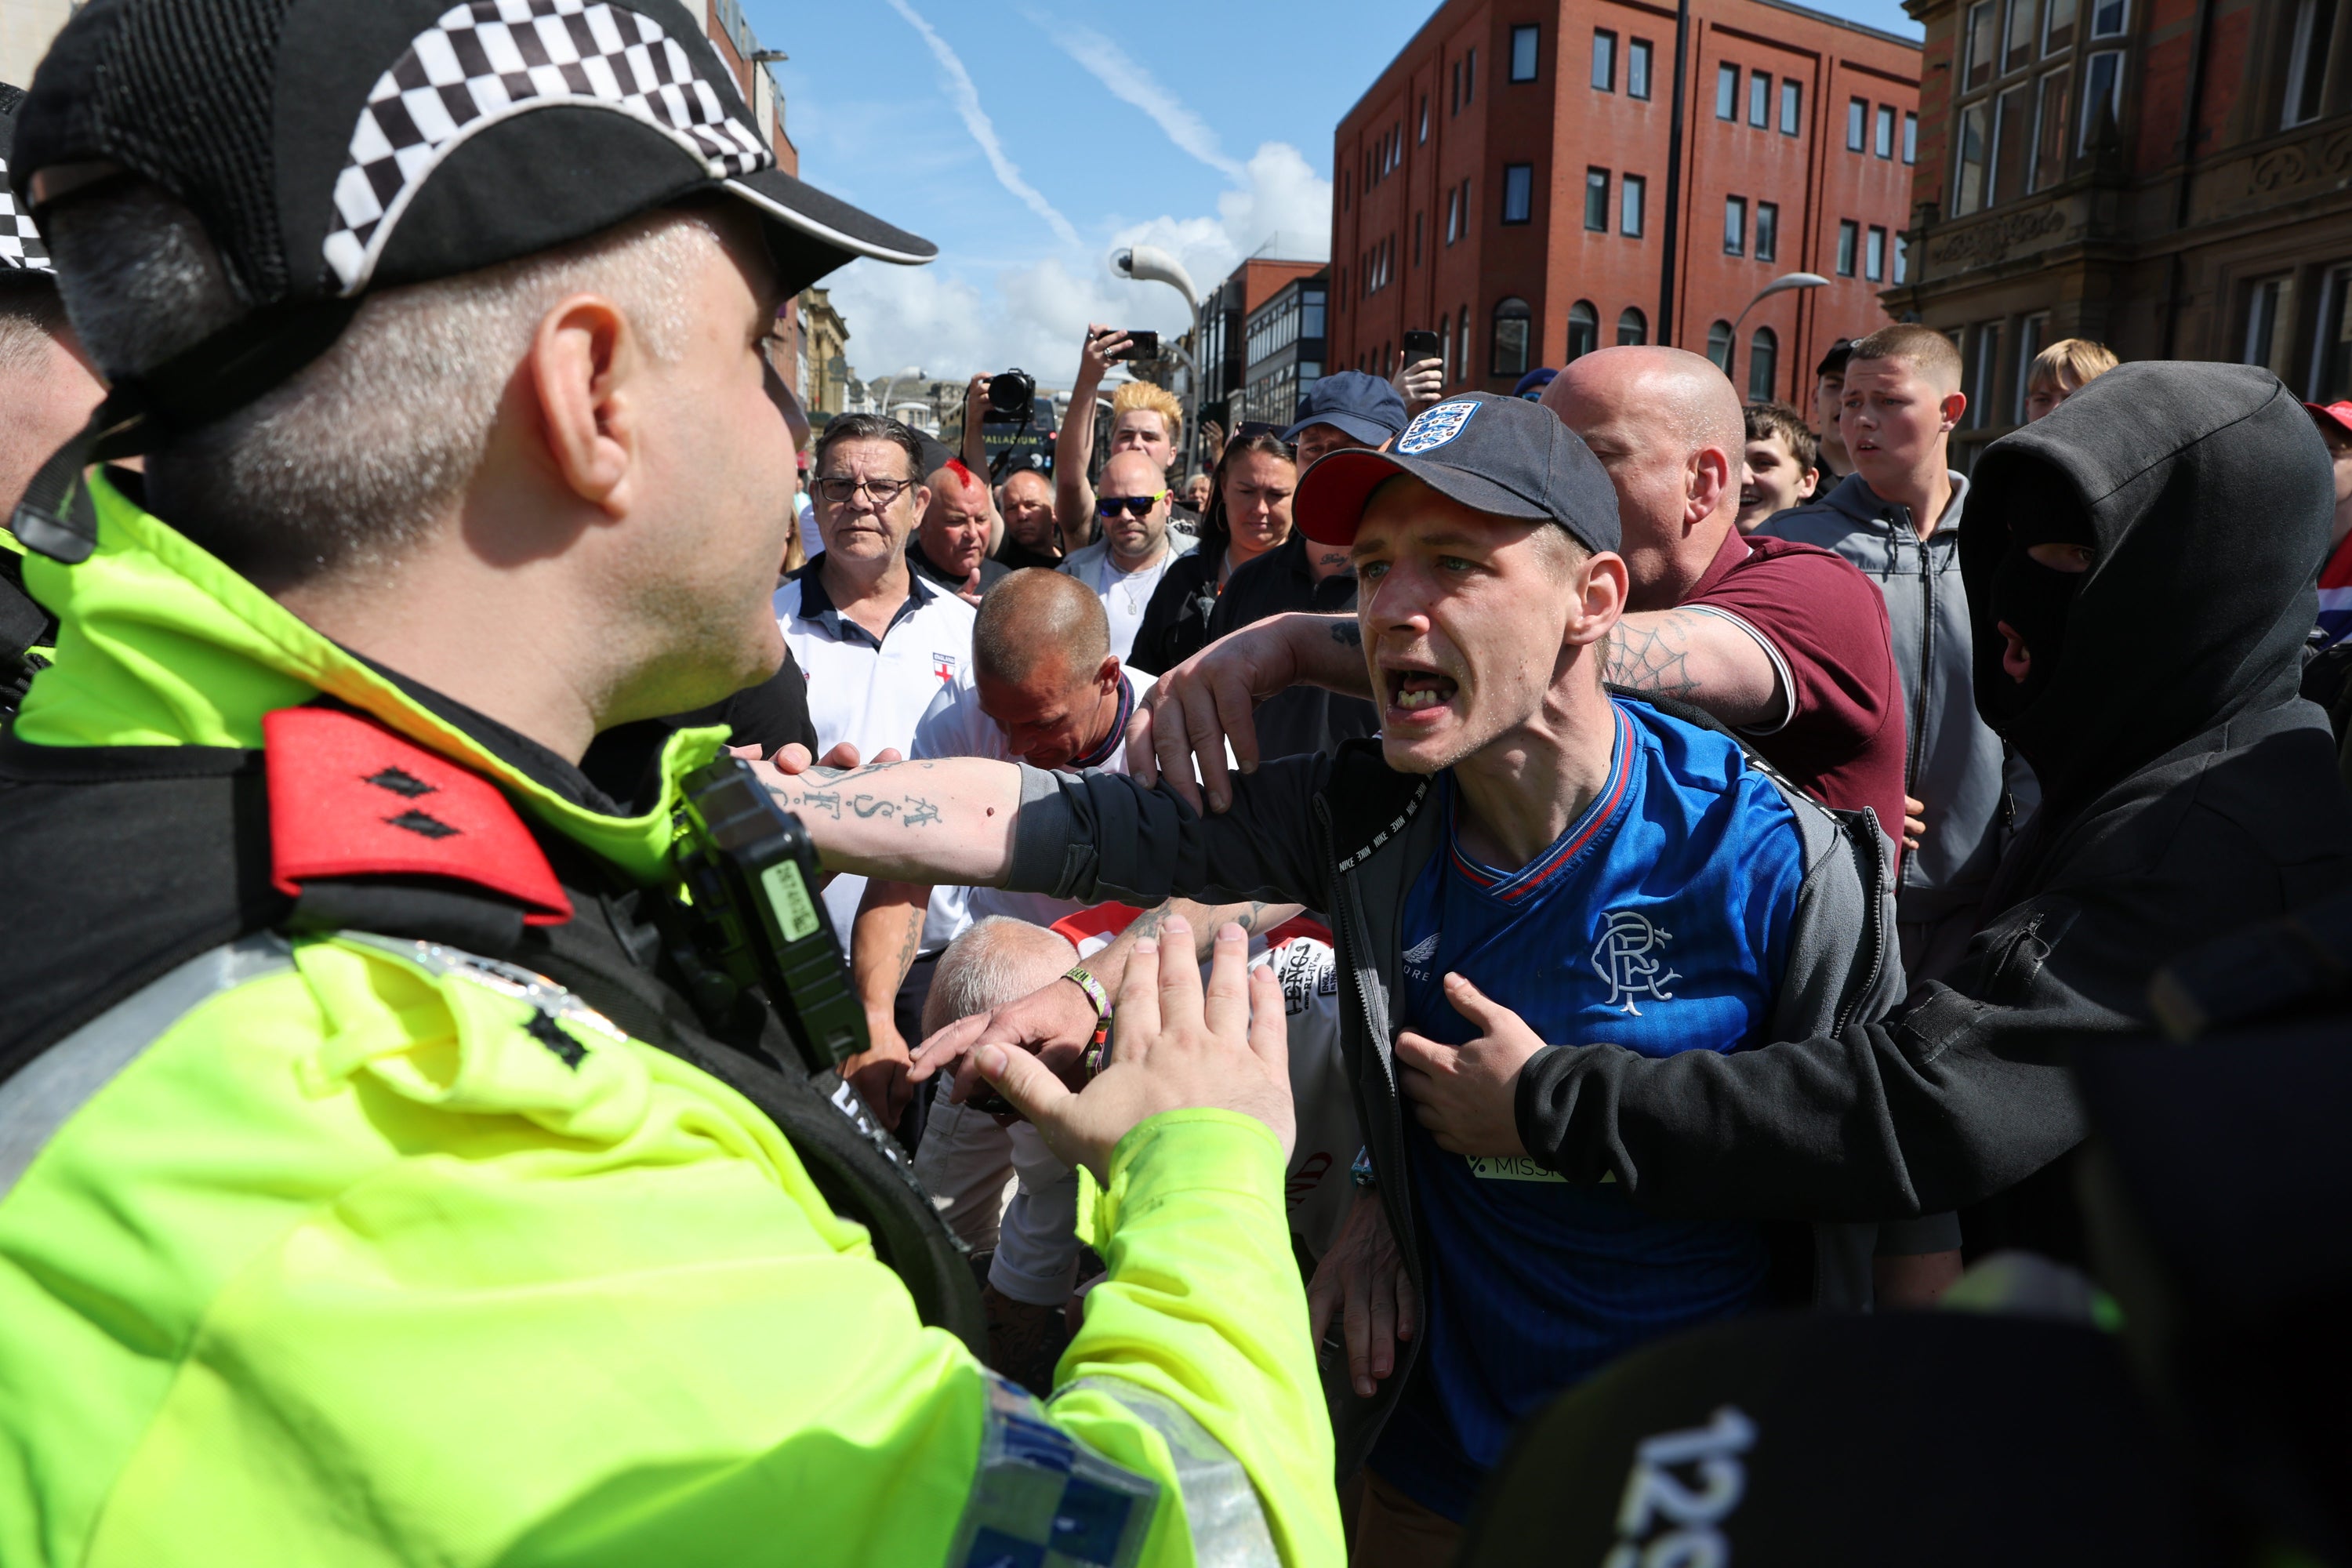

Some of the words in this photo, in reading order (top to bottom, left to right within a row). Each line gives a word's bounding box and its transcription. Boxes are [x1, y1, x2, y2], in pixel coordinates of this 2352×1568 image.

[1390, 815, 1406, 833] NIKE
[1373, 831, 1388, 848] NIKE
[1356, 845, 1371, 861] NIKE
[1339, 857, 1355, 873] NIKE
[1403, 964, 1431, 982] ORE
